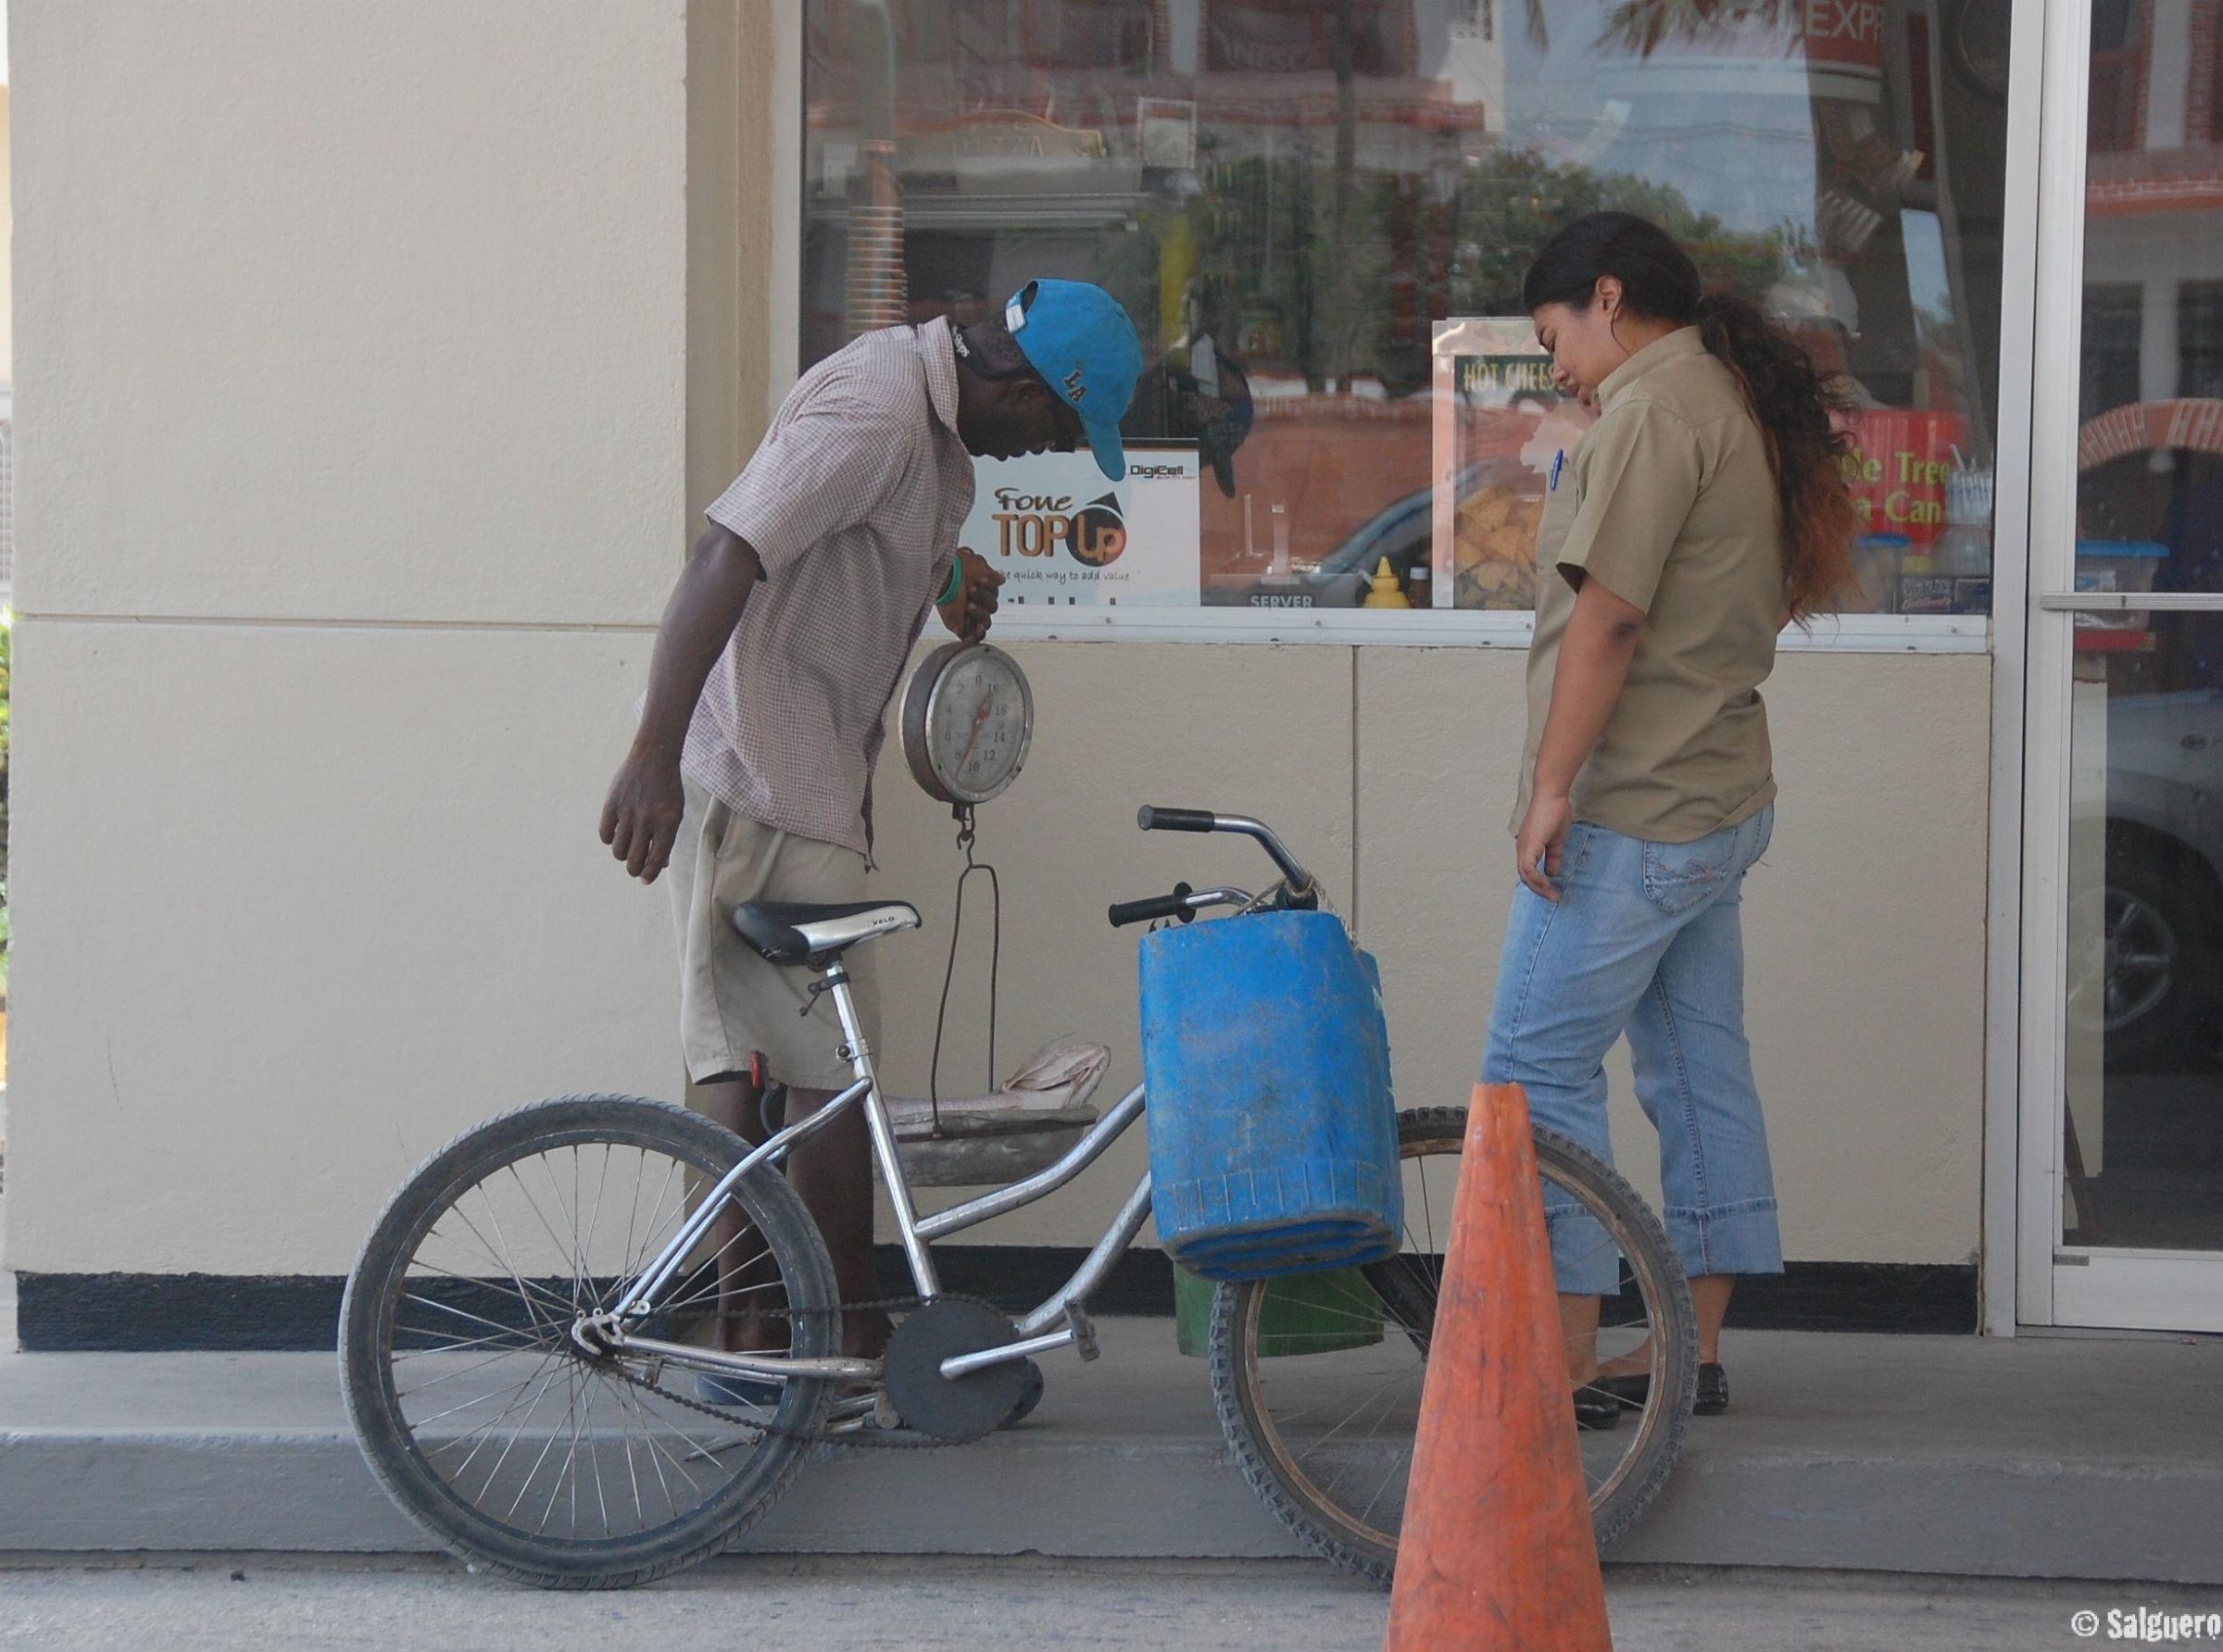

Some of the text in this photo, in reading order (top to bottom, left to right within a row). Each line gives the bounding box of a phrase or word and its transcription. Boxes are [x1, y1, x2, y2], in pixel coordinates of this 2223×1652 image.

[1464, 361, 1498, 391] HOT
[1130, 465, 1184, 479] DigiCell
[994, 487, 1074, 511] Fone
[1885, 491, 1940, 523] Can
[991, 514, 1070, 557] TOP
[1013, 569, 1043, 582] quick
[1046, 571, 1066, 584] way
[1069, 571, 1079, 581] to
[1082, 569, 1100, 581] add
[1103, 570, 1129, 581] value
[1250, 595, 1312, 608] SERVER
[994, 732, 1005, 743] 14
[984, 749, 996, 760] 12
[968, 761, 980, 771] 10
